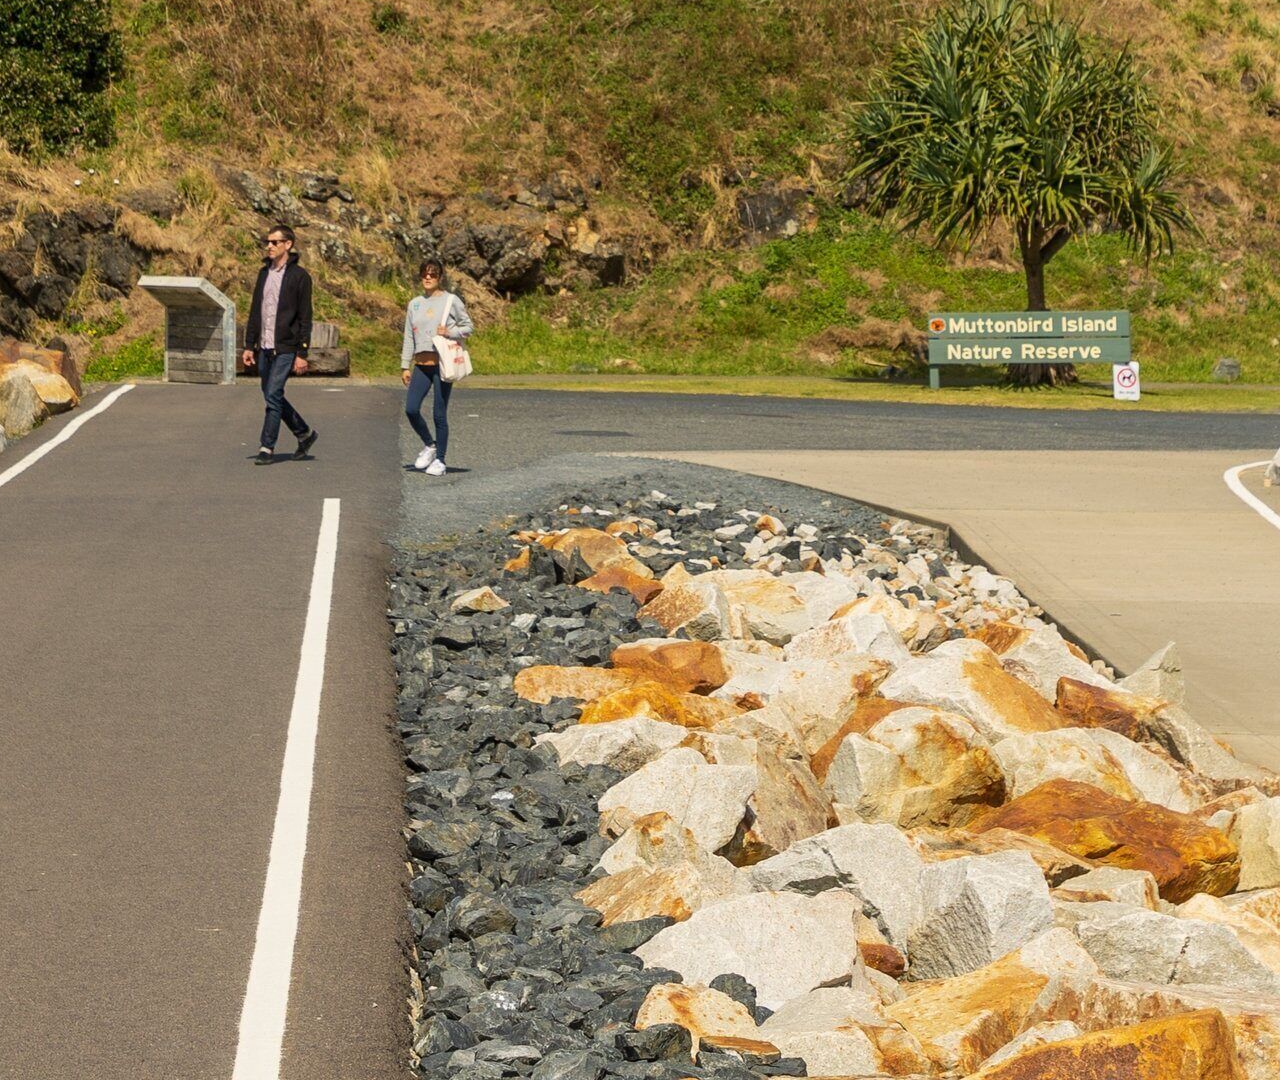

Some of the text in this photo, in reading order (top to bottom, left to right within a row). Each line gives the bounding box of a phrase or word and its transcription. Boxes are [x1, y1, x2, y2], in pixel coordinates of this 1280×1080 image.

[949, 316, 1117, 333] Muttonbird Island
[947, 343, 1101, 360] Nature Reserve
